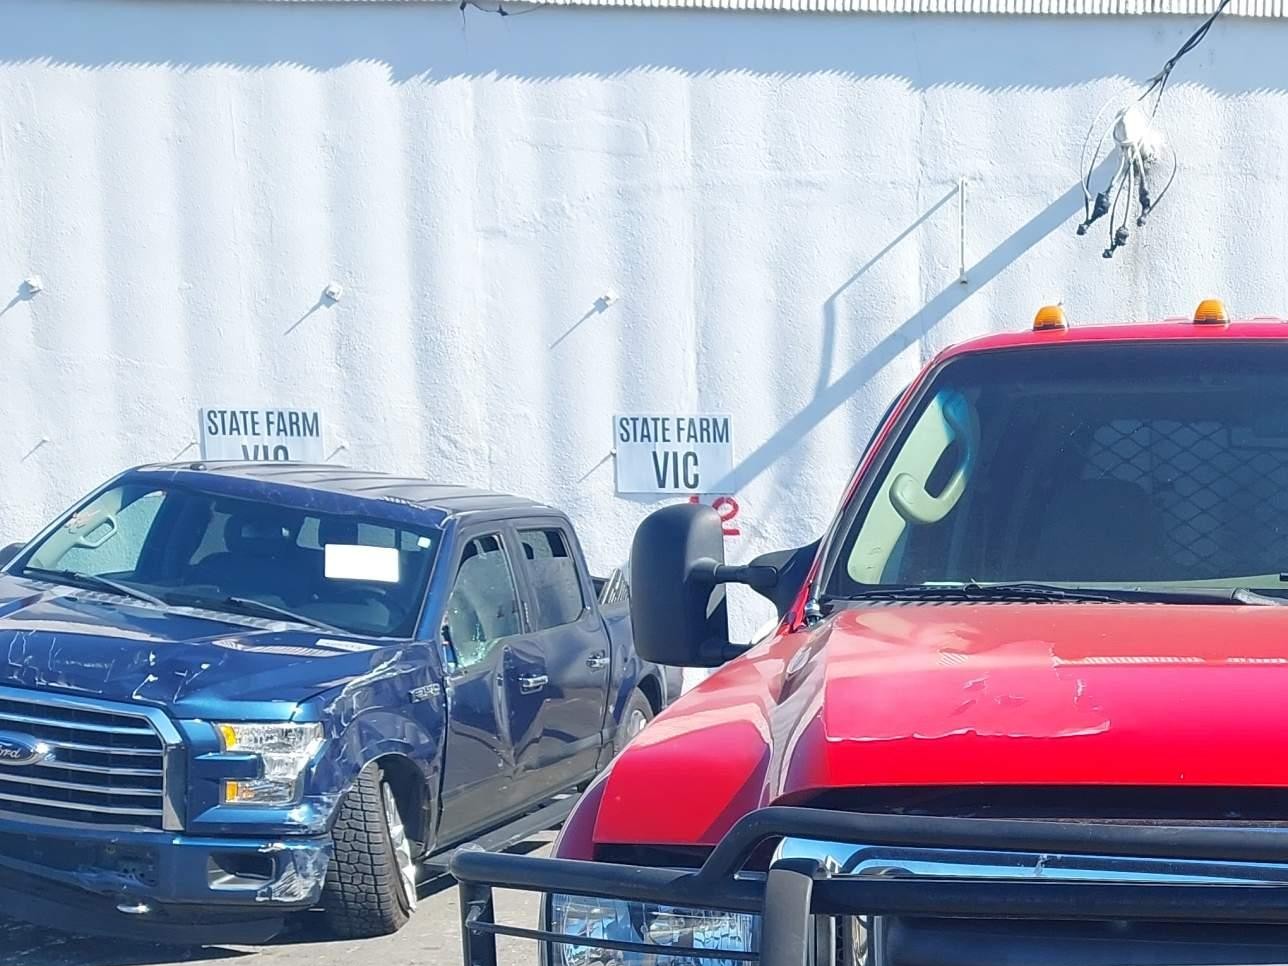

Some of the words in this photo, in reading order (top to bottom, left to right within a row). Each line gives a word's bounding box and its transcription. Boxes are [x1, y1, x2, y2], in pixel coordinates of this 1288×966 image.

[207, 410, 260, 436] STATE
[265, 411, 319, 437] FARM
[619, 417, 671, 443] STATE
[676, 417, 729, 443] FARM
[652, 451, 699, 489] VIC
